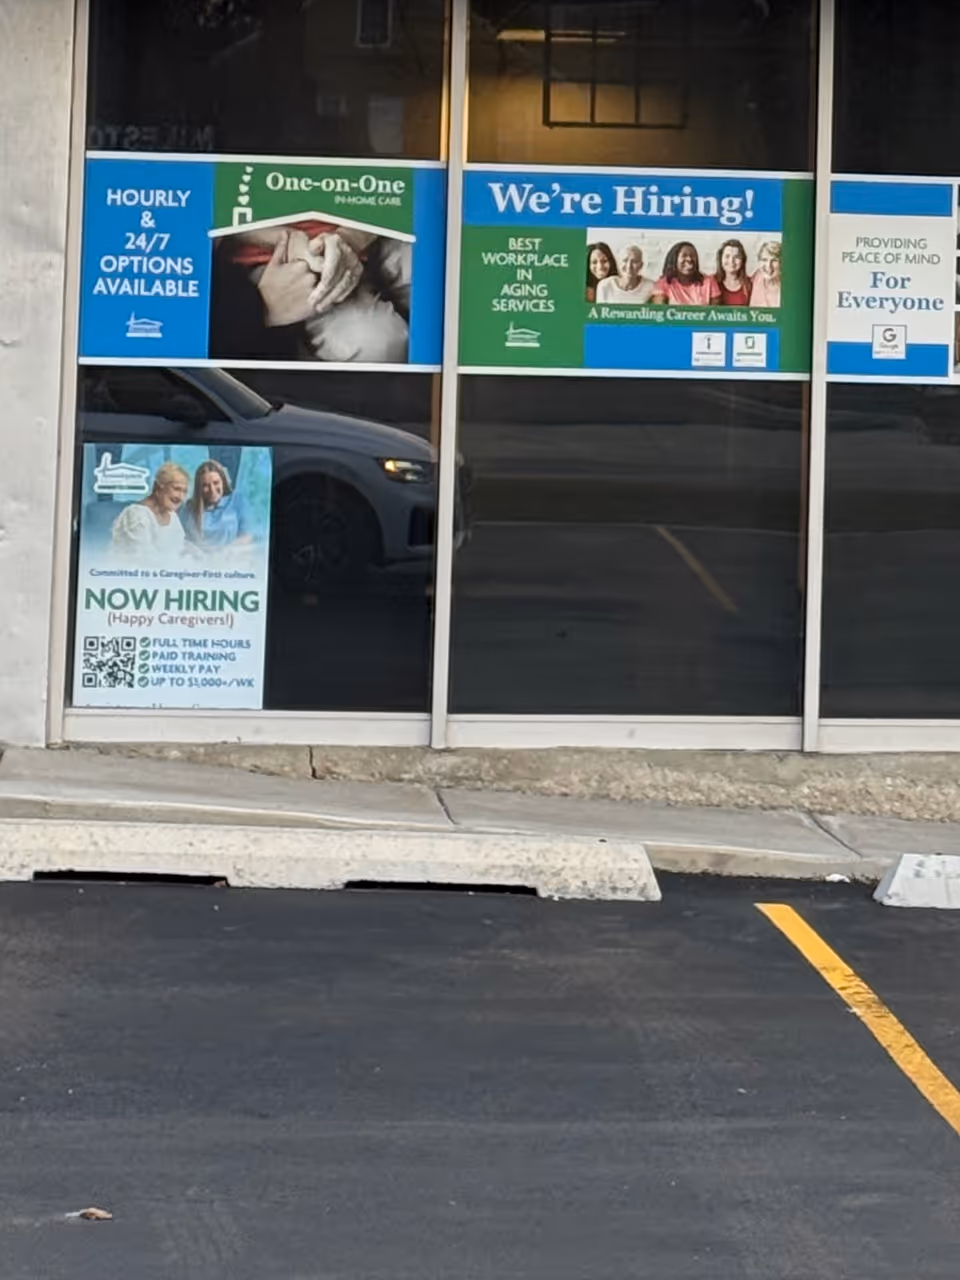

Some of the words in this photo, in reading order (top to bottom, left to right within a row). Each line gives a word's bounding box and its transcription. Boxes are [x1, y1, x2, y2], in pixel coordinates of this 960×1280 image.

[265, 172, 406, 194] One-on-One
[106, 188, 192, 208] HOURLY
[378, 196, 402, 206] CARE
[487, 182, 602, 215] We're
[612, 184, 755, 226] Hiring!
[140, 211, 156, 228] &
[124, 233, 171, 254] 24/7
[508, 238, 542, 252] BEST
[855, 236, 928, 251] PROVIDING
[99, 255, 194, 275] OPTIONS
[481, 252, 569, 268] WORKPLACE
[841, 251, 881, 265] PEACE
[884, 252, 901, 265] OF
[903, 253, 942, 266] MIND
[516, 268, 533, 281] IN
[869, 271, 912, 290] For
[92, 278, 200, 298] AVAILABLE
[499, 282, 549, 298] AGING
[491, 297, 556, 313] SERVICES
[836, 291, 945, 314] Everyone
[587, 306, 599, 319] A
[600, 307, 666, 322] Rewarding
[665, 308, 705, 321] Career
[707, 310, 749, 322] Awaits
[749, 311, 778, 323] You.
[84, 588, 159, 611] NOW
[163, 588, 260, 613] HIRING
[107, 612, 155, 628] (Happy
[157, 612, 235, 629] Caregivers!)
[151, 637, 179, 648] FULL
[181, 638, 208, 649] TIME
[210, 639, 252, 650] HOURS
[151, 650, 179, 661] PAID
[180, 651, 237, 662] TRAINING
[150, 663, 197, 675] WEEKLY
[198, 664, 222, 675] PAY
[150, 676, 166, 688] UP
[168, 677, 185, 688] TO
